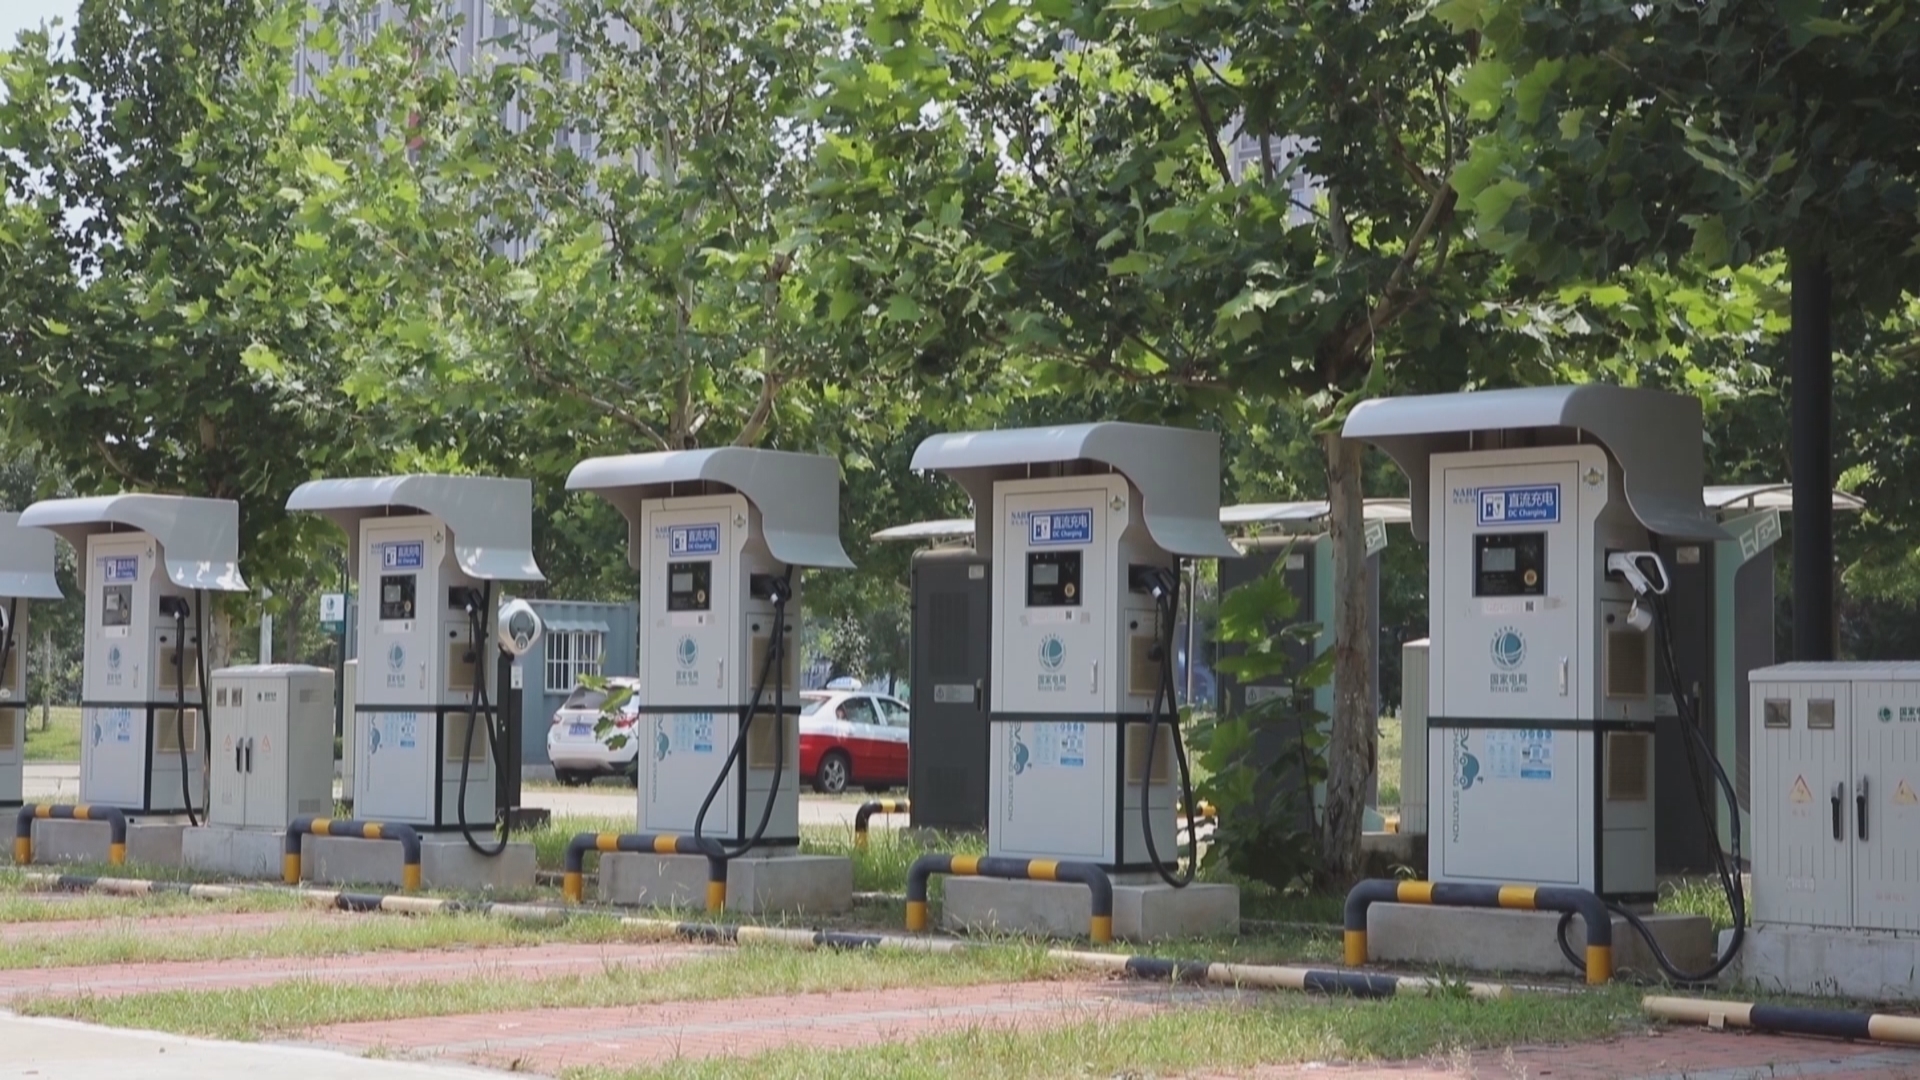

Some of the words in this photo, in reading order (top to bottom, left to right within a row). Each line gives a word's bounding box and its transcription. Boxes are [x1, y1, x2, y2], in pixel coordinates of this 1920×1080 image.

[1508, 491, 1554, 508] 直流充电
[1508, 509, 1518, 517] DC
[1519, 507, 1547, 518] Charging
[1053, 514, 1088, 529] 直流充电
[1061, 529, 1082, 539] Charging
[1490, 673, 1527, 686] 国家电网
